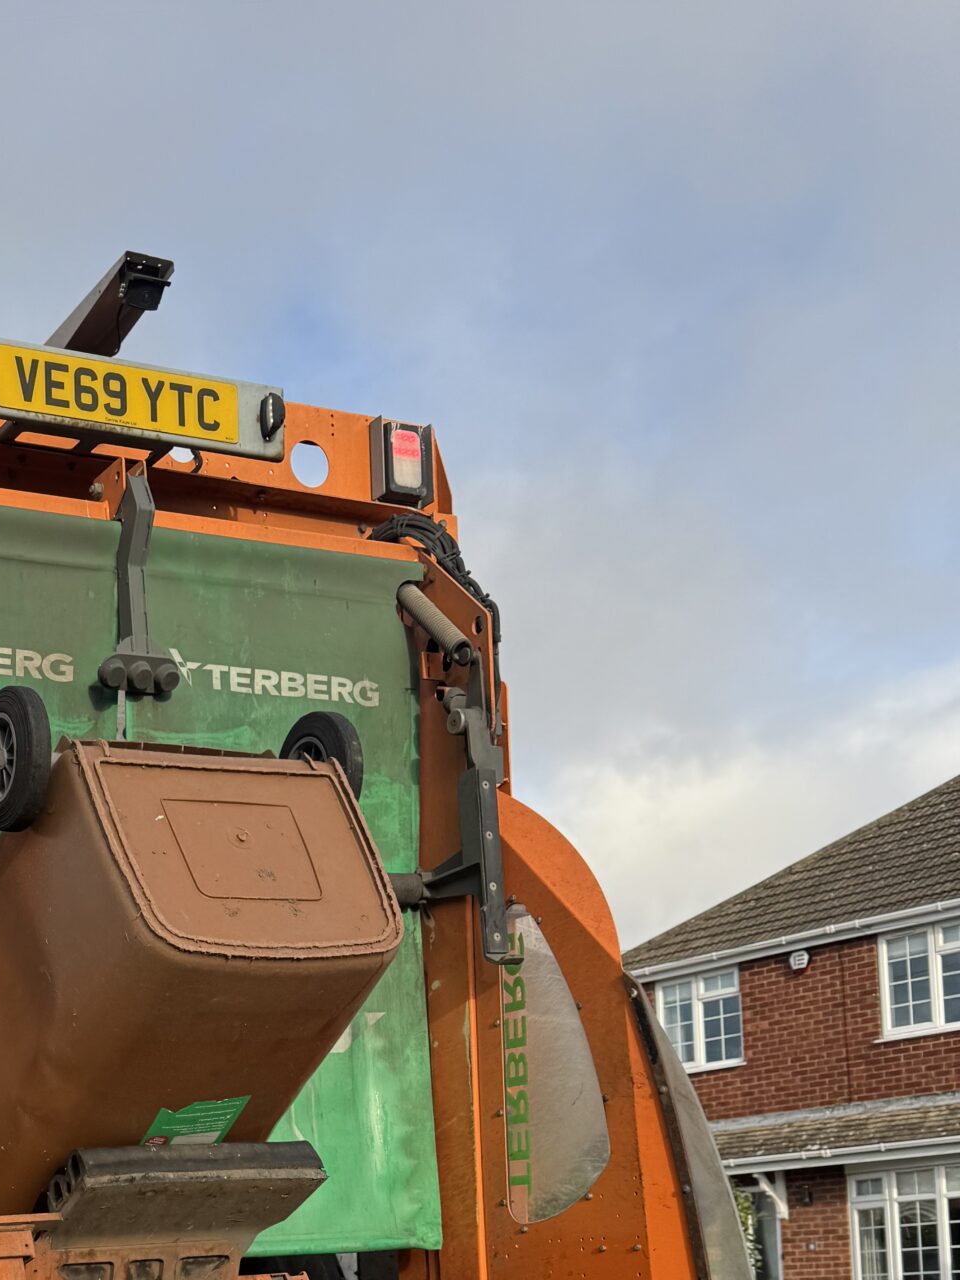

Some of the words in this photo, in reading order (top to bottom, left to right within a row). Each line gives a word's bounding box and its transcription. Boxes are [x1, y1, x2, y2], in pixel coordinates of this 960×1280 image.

[14, 355, 128, 417] VE69
[141, 377, 221, 432] YTC
[202, 665, 379, 707] TERBERG
